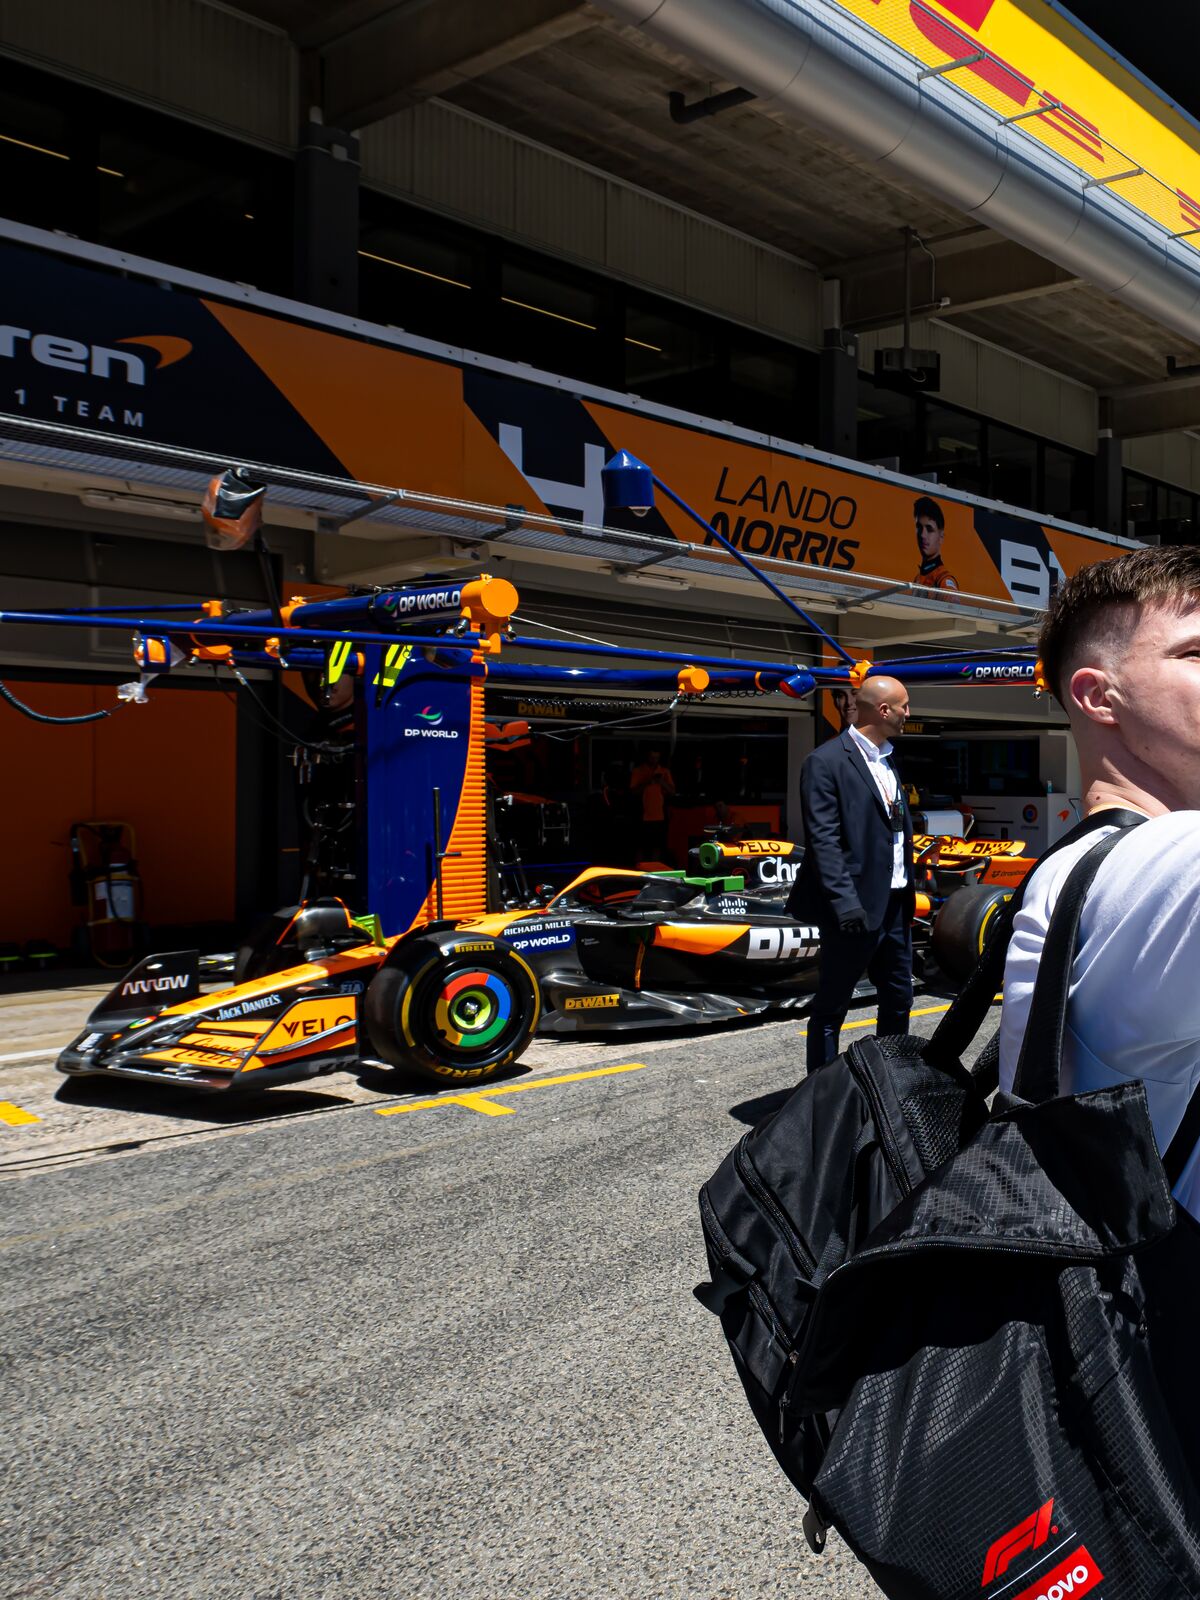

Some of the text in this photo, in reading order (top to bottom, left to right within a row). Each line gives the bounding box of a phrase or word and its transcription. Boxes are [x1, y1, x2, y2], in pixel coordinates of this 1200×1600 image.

[14, 389, 144, 427] 1 TEAM
[714, 466, 857, 530] LANDO
[703, 511, 860, 571] NORRIS
[399, 590, 461, 612] DP WORLD
[975, 665, 1035, 678] DP WORLD
[404, 728, 459, 739] DP WORLD
[758, 856, 801, 883] Chr
[503, 920, 571, 936] RICHARD MILLE
[454, 941, 496, 953] PIRELLI
[513, 941, 529, 950] DP
[529, 934, 571, 947] WORLD
